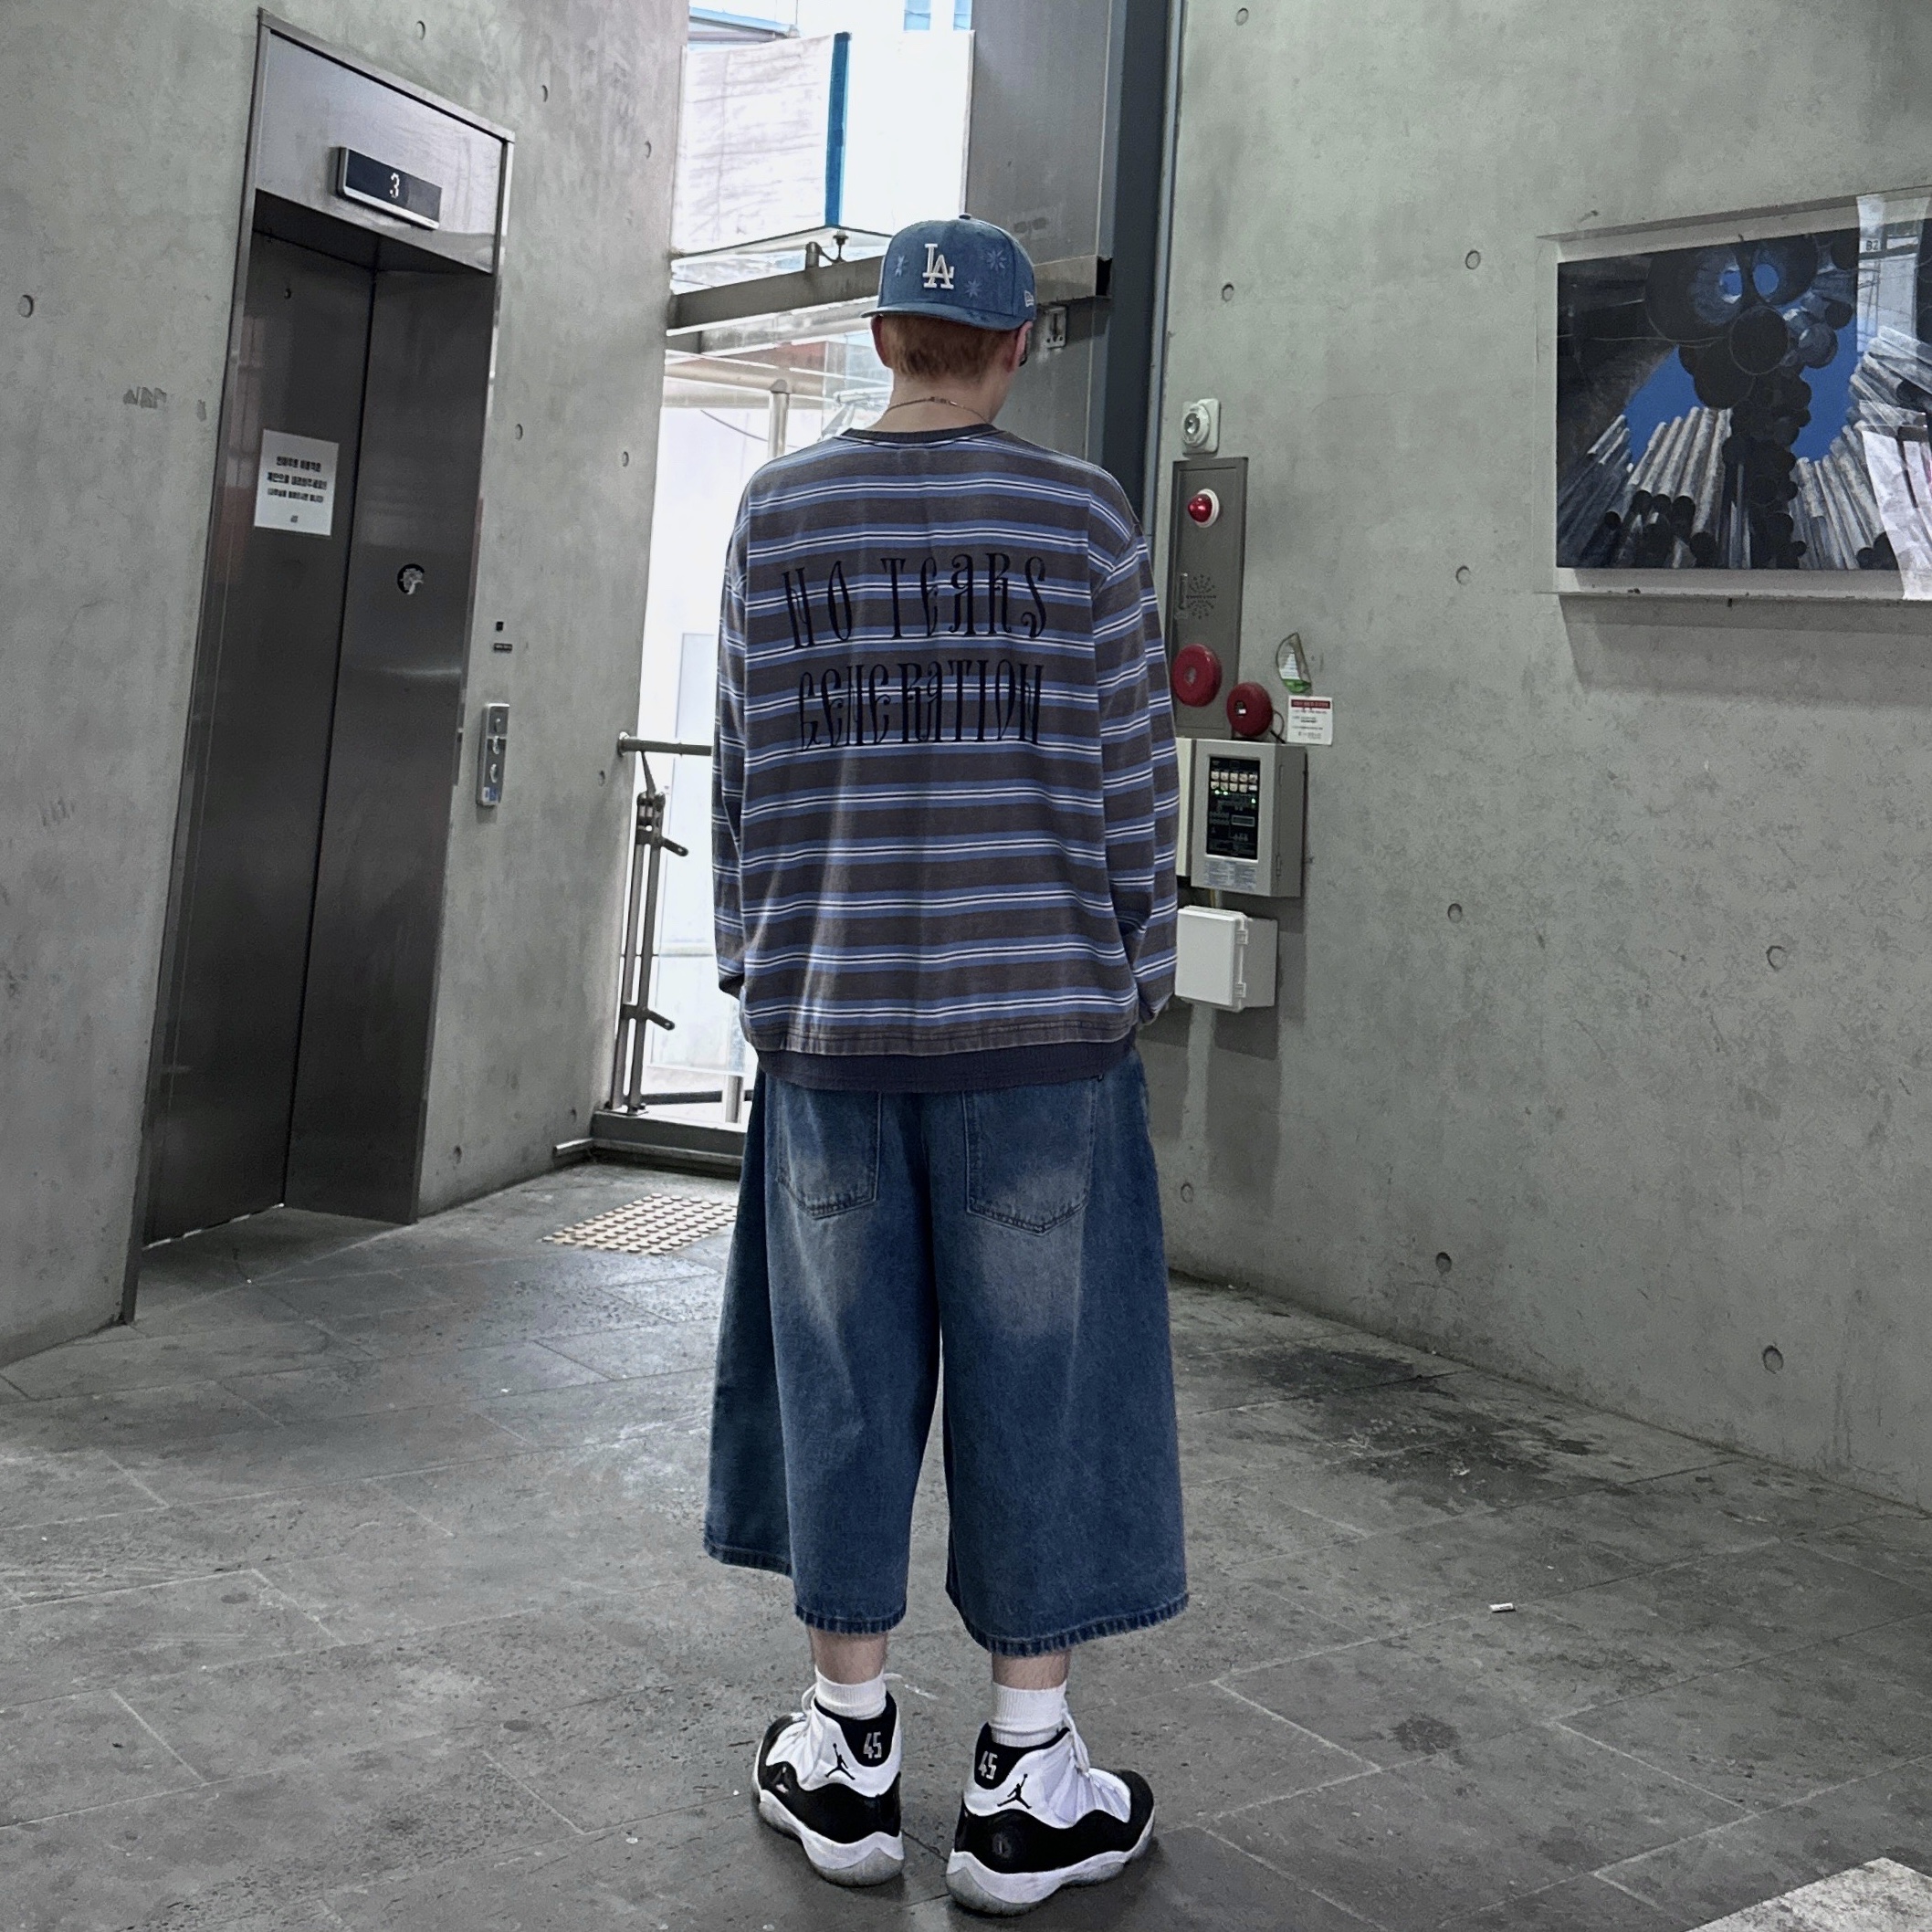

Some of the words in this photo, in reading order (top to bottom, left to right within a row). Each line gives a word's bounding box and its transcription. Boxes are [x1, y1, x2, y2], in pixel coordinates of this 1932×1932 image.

[390, 173, 400, 199] 3
[922, 243, 955, 289] LA
[782, 560, 854, 650] NO
[879, 551, 1047, 640] TEARS
[797, 658, 1045, 751] GENERATION
[863, 1731, 883, 1759] 45
[978, 1750, 998, 1780] 45
